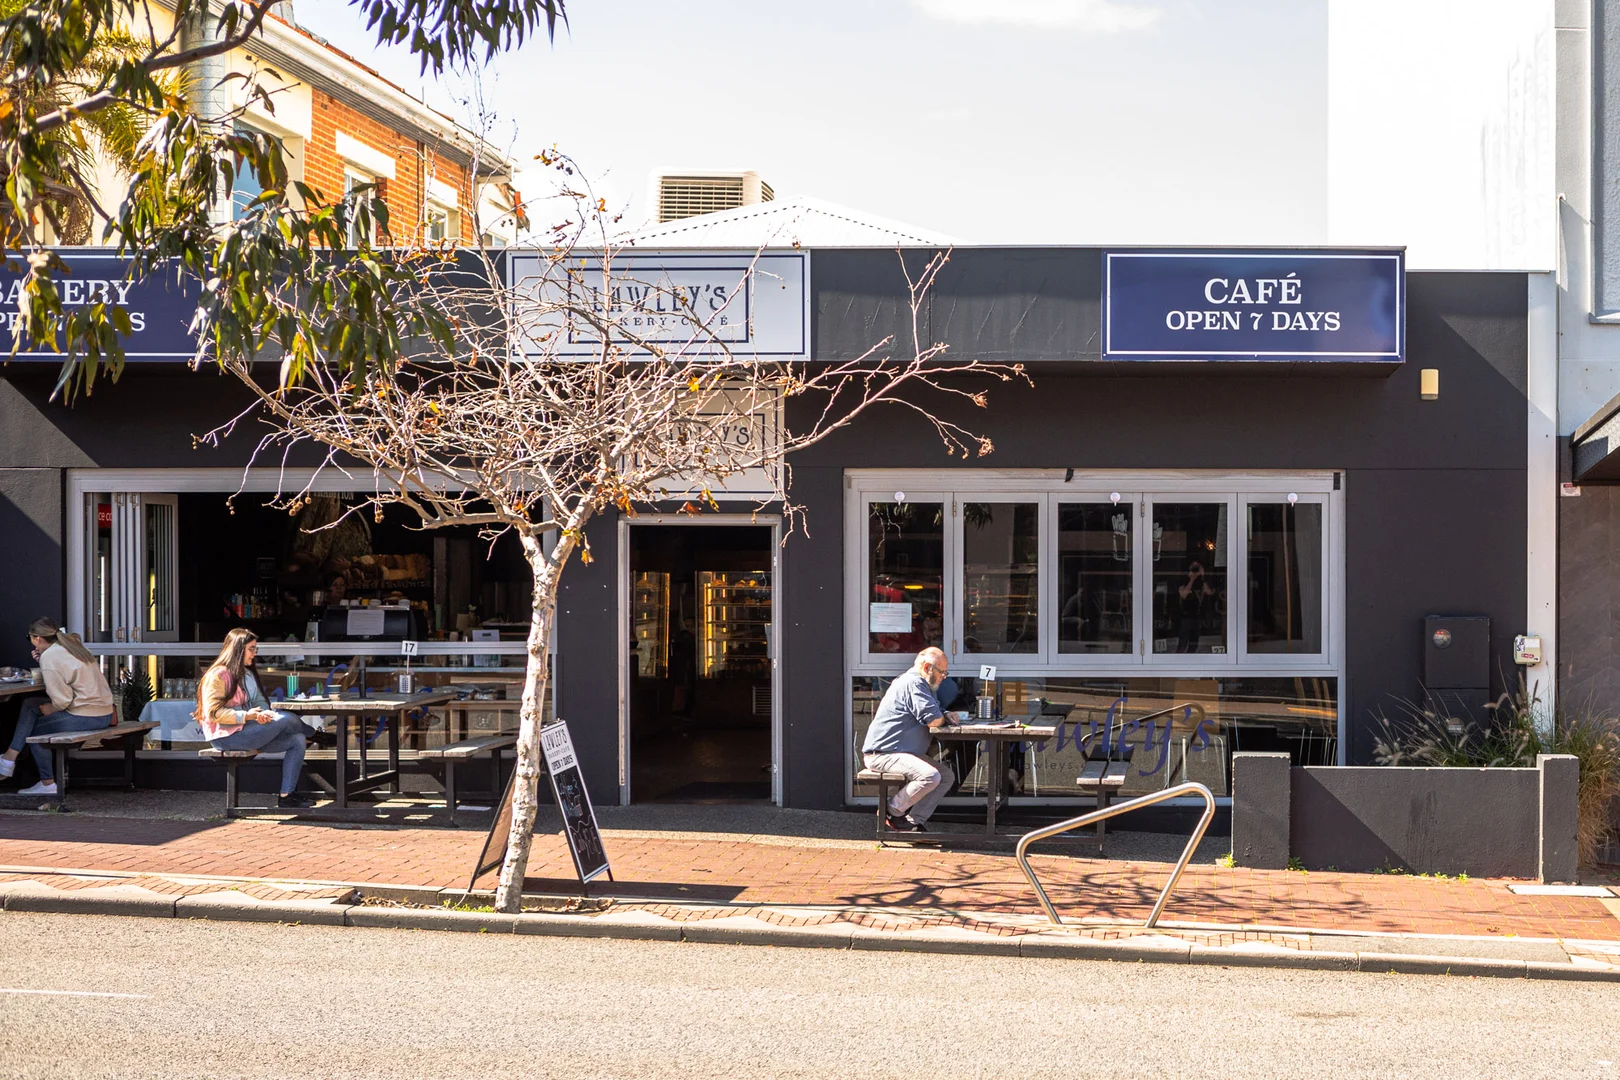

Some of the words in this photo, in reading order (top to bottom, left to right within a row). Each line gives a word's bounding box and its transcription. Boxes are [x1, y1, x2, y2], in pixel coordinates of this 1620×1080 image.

[0, 280, 135, 305] AERY
[592, 284, 728, 313] LAWLEY'S
[1204, 272, 1302, 304] CAFÉ
[1165, 310, 1242, 331] OPEN
[1250, 312, 1264, 331] 7
[1271, 311, 1341, 332] DAYS
[405, 643, 415, 653] 17
[985, 667, 992, 677] 7
